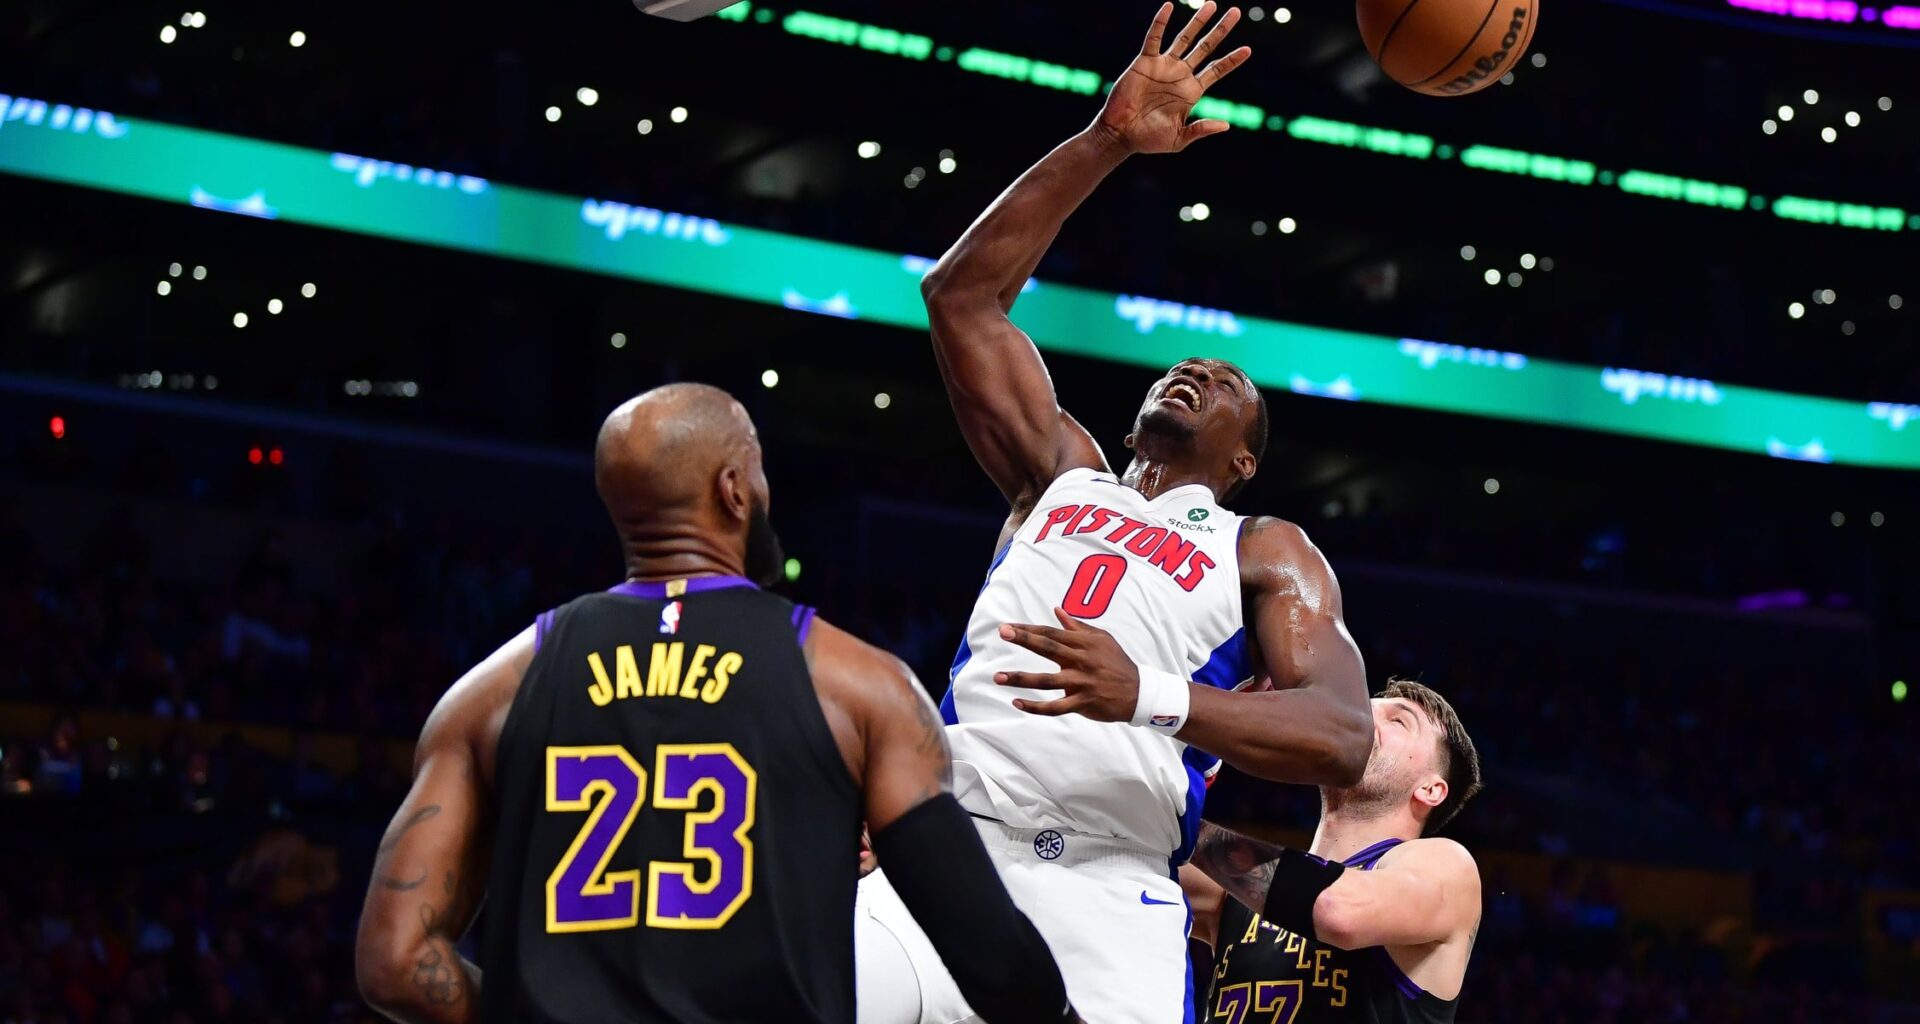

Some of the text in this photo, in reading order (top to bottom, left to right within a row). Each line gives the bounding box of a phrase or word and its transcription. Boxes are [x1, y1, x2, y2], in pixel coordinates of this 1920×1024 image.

[1436, 6, 1527, 94] Wilson
[1035, 504, 1216, 592] PISTONS
[1063, 554, 1128, 619] 0
[587, 642, 743, 706] JAMES
[545, 743, 758, 933] 23
[1214, 979, 1304, 1024] 77
